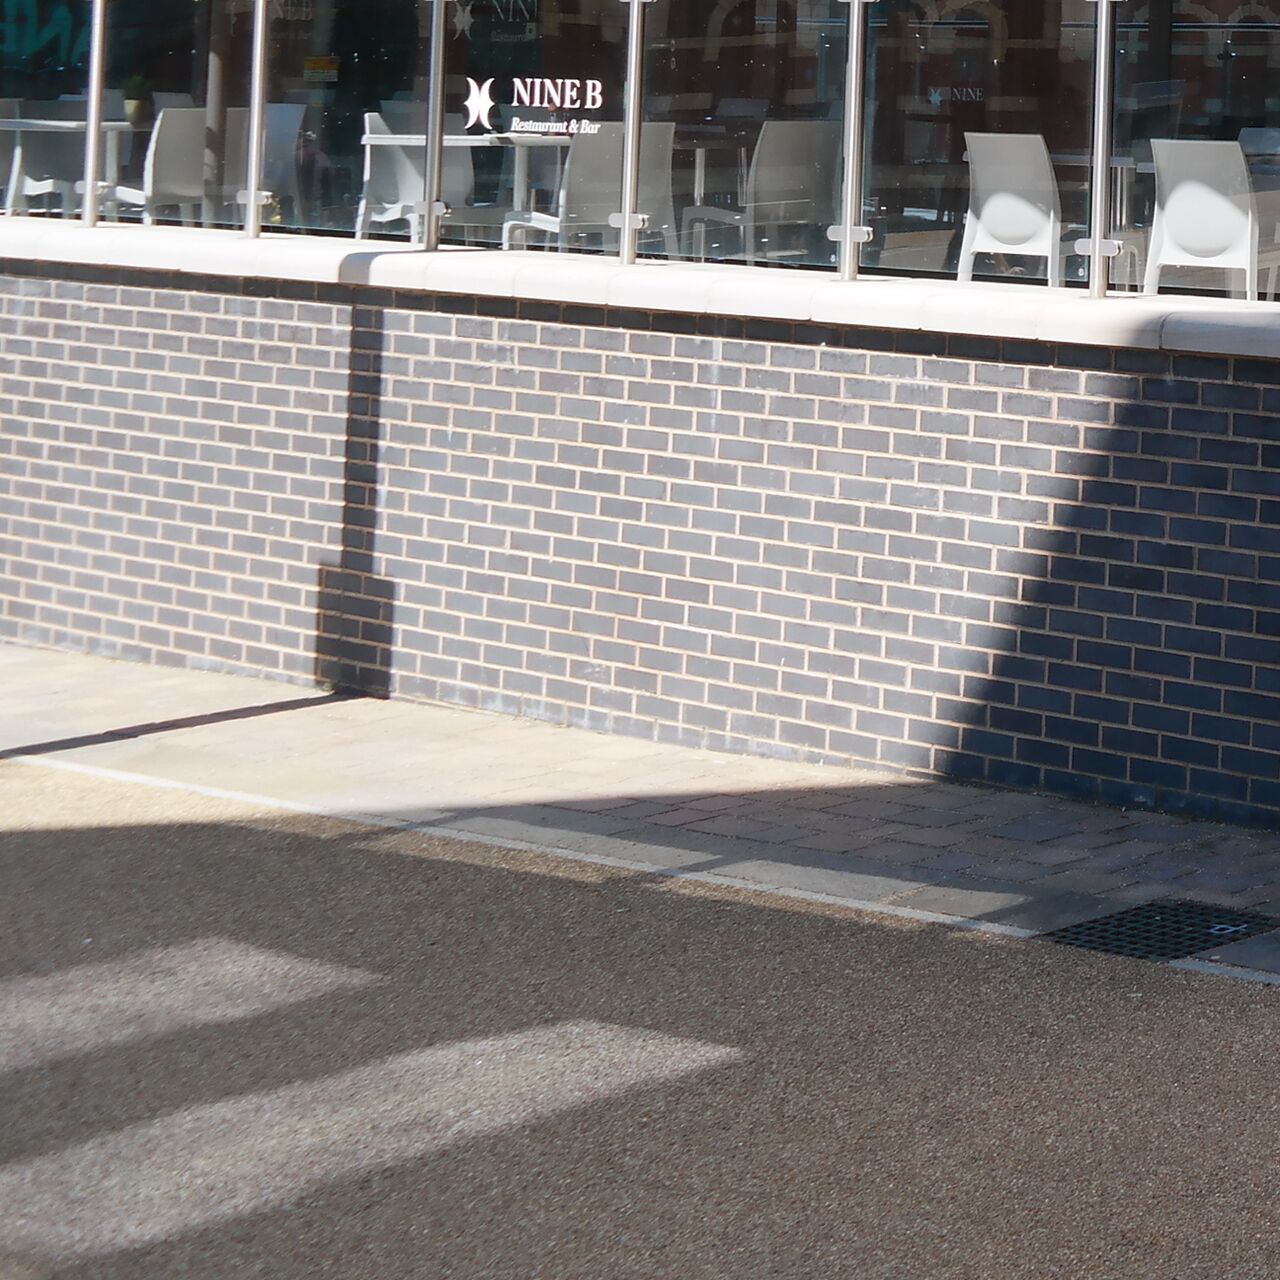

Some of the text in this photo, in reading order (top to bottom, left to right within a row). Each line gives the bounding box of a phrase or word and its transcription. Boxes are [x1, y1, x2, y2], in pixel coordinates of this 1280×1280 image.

[511, 77, 603, 109] NINE B
[510, 116, 602, 134] Restaurant & Bar
